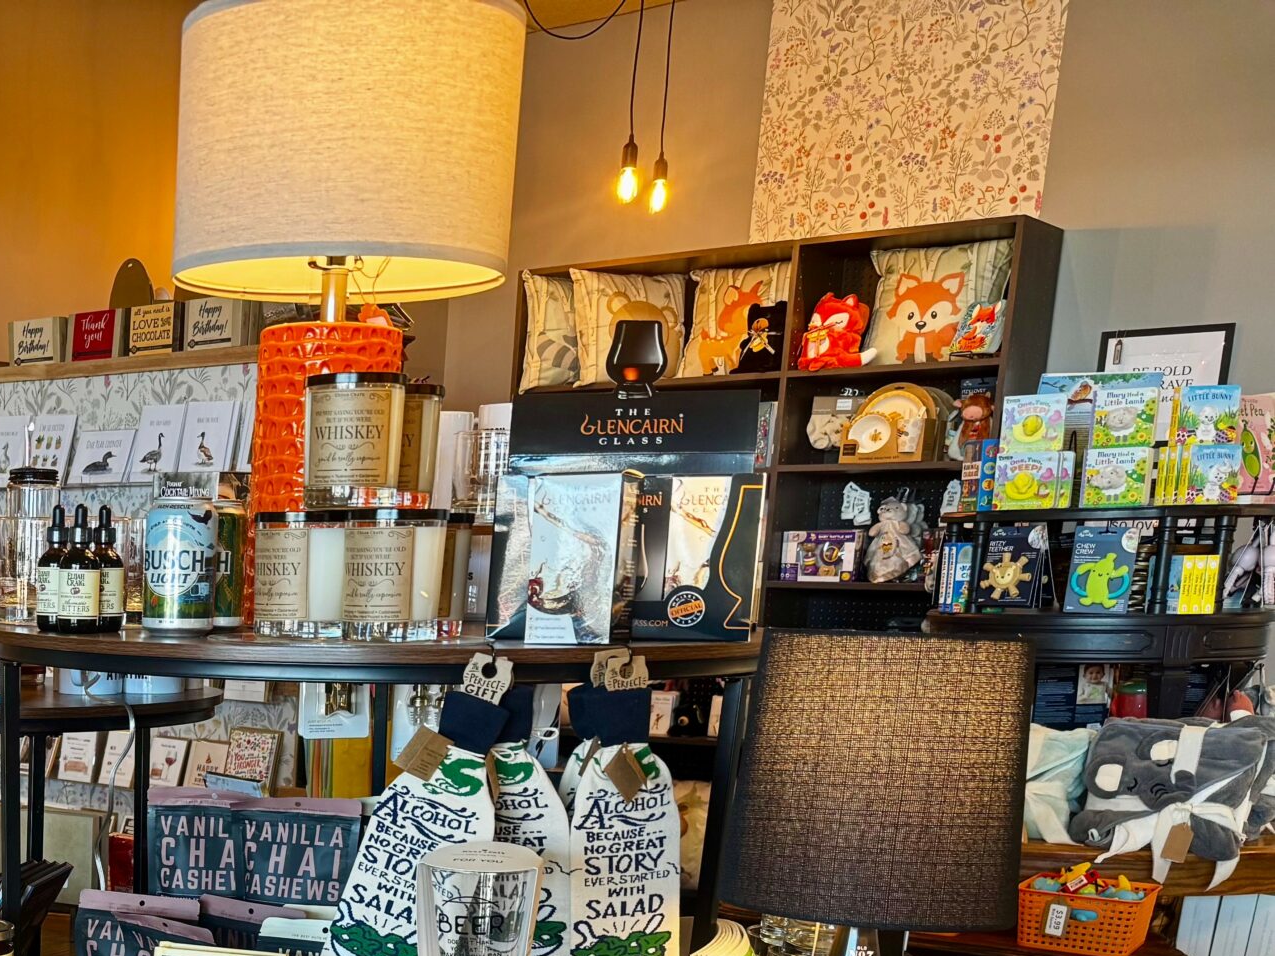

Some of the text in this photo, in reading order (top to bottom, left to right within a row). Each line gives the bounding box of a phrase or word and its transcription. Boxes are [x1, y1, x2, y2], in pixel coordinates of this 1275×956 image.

[199, 301, 222, 317] Happy
[80, 313, 110, 332] Thank
[132, 317, 159, 330] LOVE
[192, 319, 228, 337] Birthday!
[22, 323, 43, 340] Happy
[84, 331, 104, 348] you!
[132, 329, 170, 343] CHOCOLATE
[18, 339, 50, 355] Birthday!
[1188, 392, 1233, 402] LITTLE BUNNY
[615, 408, 651, 416] THE
[315, 424, 385, 441] WHISKEY
[580, 414, 684, 435] GLENCAIRN
[598, 437, 663, 445] GLASS
[1097, 451, 1117, 460] Mary
[1009, 464, 1042, 474] PEEP!
[145, 550, 206, 573] BUSCH
[150, 573, 191, 584] LIGHT
[671, 603, 702, 617] OFFICIAL
[469, 673, 501, 690] PERFECT
[464, 684, 498, 700] GIFT
[574, 793, 670, 830] ALCOHOL
[244, 819, 343, 848] VANILLA
[583, 836, 667, 855] NO GREAT
[244, 842, 340, 880] CHAI
[584, 849, 665, 875] STORY
[584, 870, 670, 887] EVER STARTED
[244, 873, 340, 902] CASHEWS
[608, 885, 645, 897] WITH
[585, 893, 664, 920] SALAD
[438, 913, 504, 935] BEER
